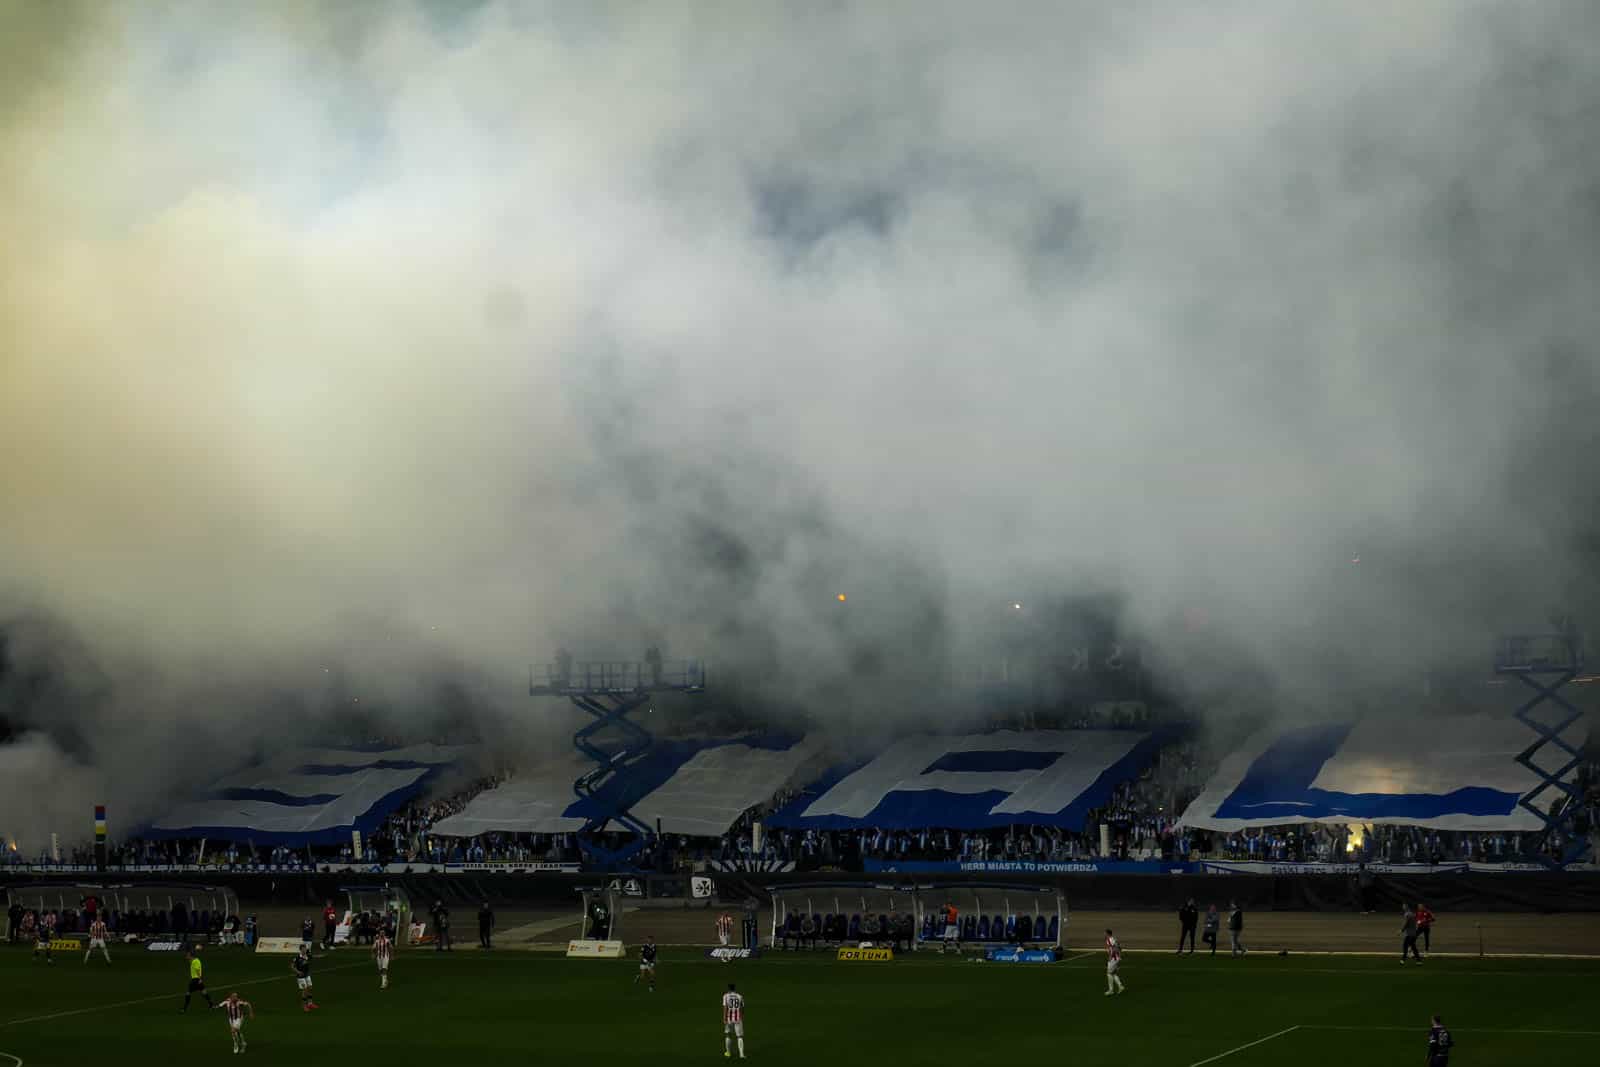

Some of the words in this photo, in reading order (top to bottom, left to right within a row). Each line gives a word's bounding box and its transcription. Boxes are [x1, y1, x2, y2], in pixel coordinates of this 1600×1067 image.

[961, 862, 985, 871] HERB
[987, 862, 1022, 871] MIASTA
[1023, 862, 1035, 871] TO
[1037, 864, 1098, 872] POTWIERDZA
[839, 950, 888, 960] FORTUNA
